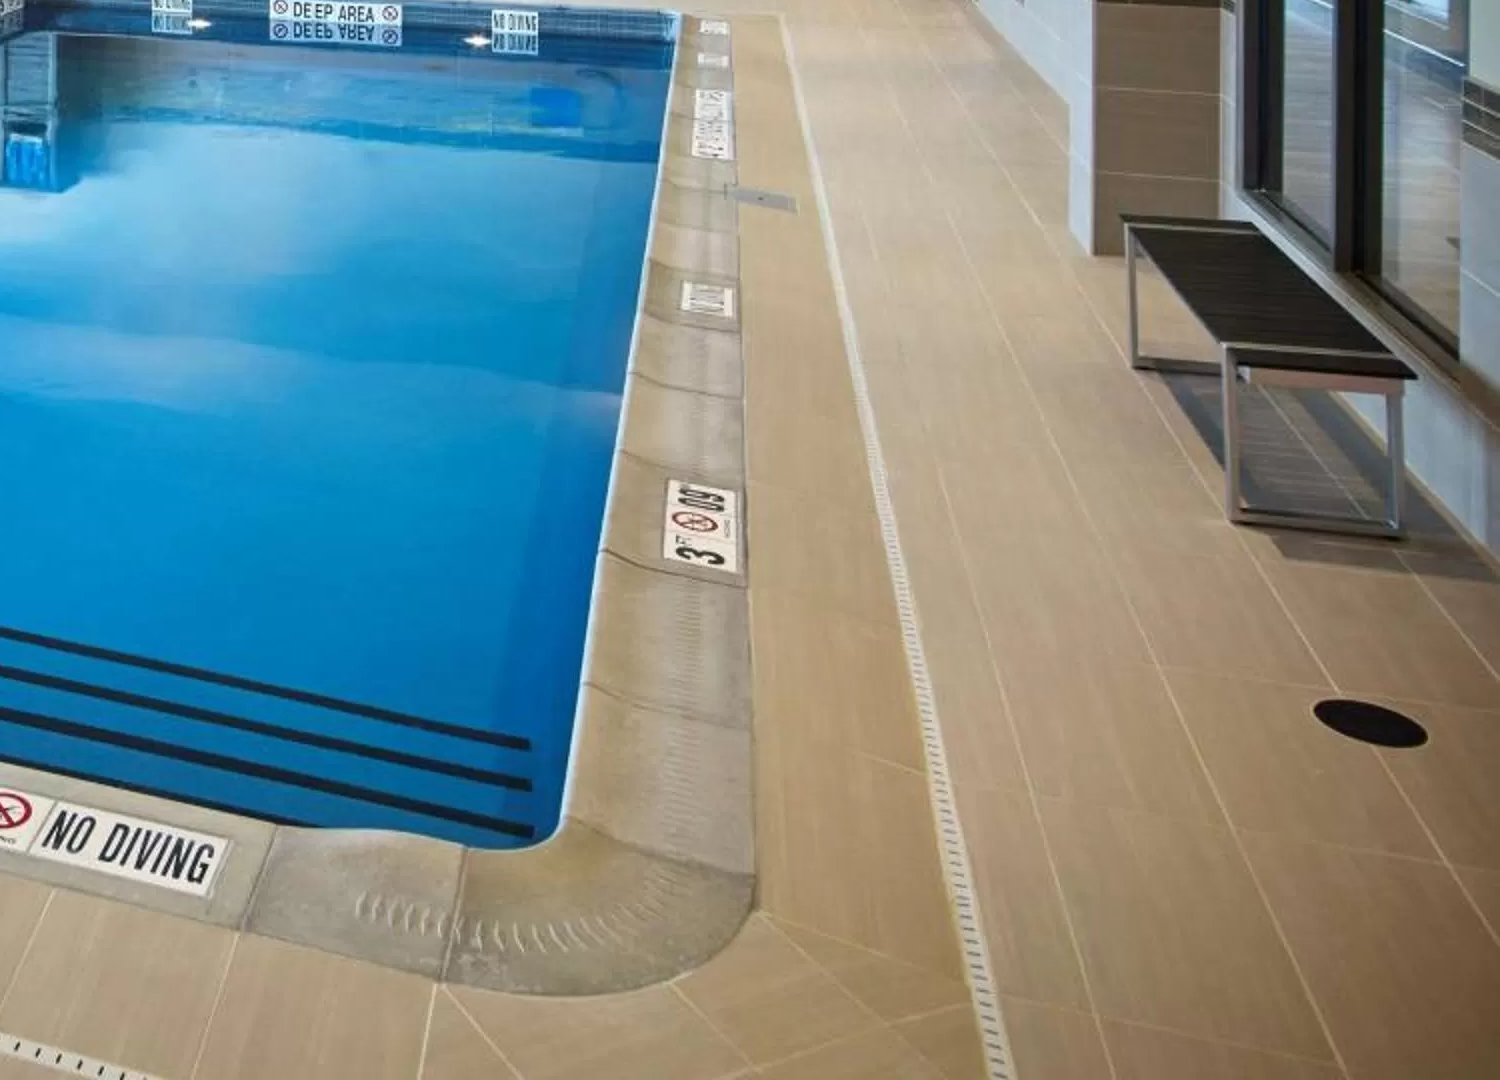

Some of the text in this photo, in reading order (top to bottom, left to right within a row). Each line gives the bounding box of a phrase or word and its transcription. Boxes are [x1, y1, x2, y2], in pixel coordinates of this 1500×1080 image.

[293, 1, 375, 22] DEEP AREA
[675, 547, 725, 565] 3
[41, 809, 215, 885] NO DIVING
